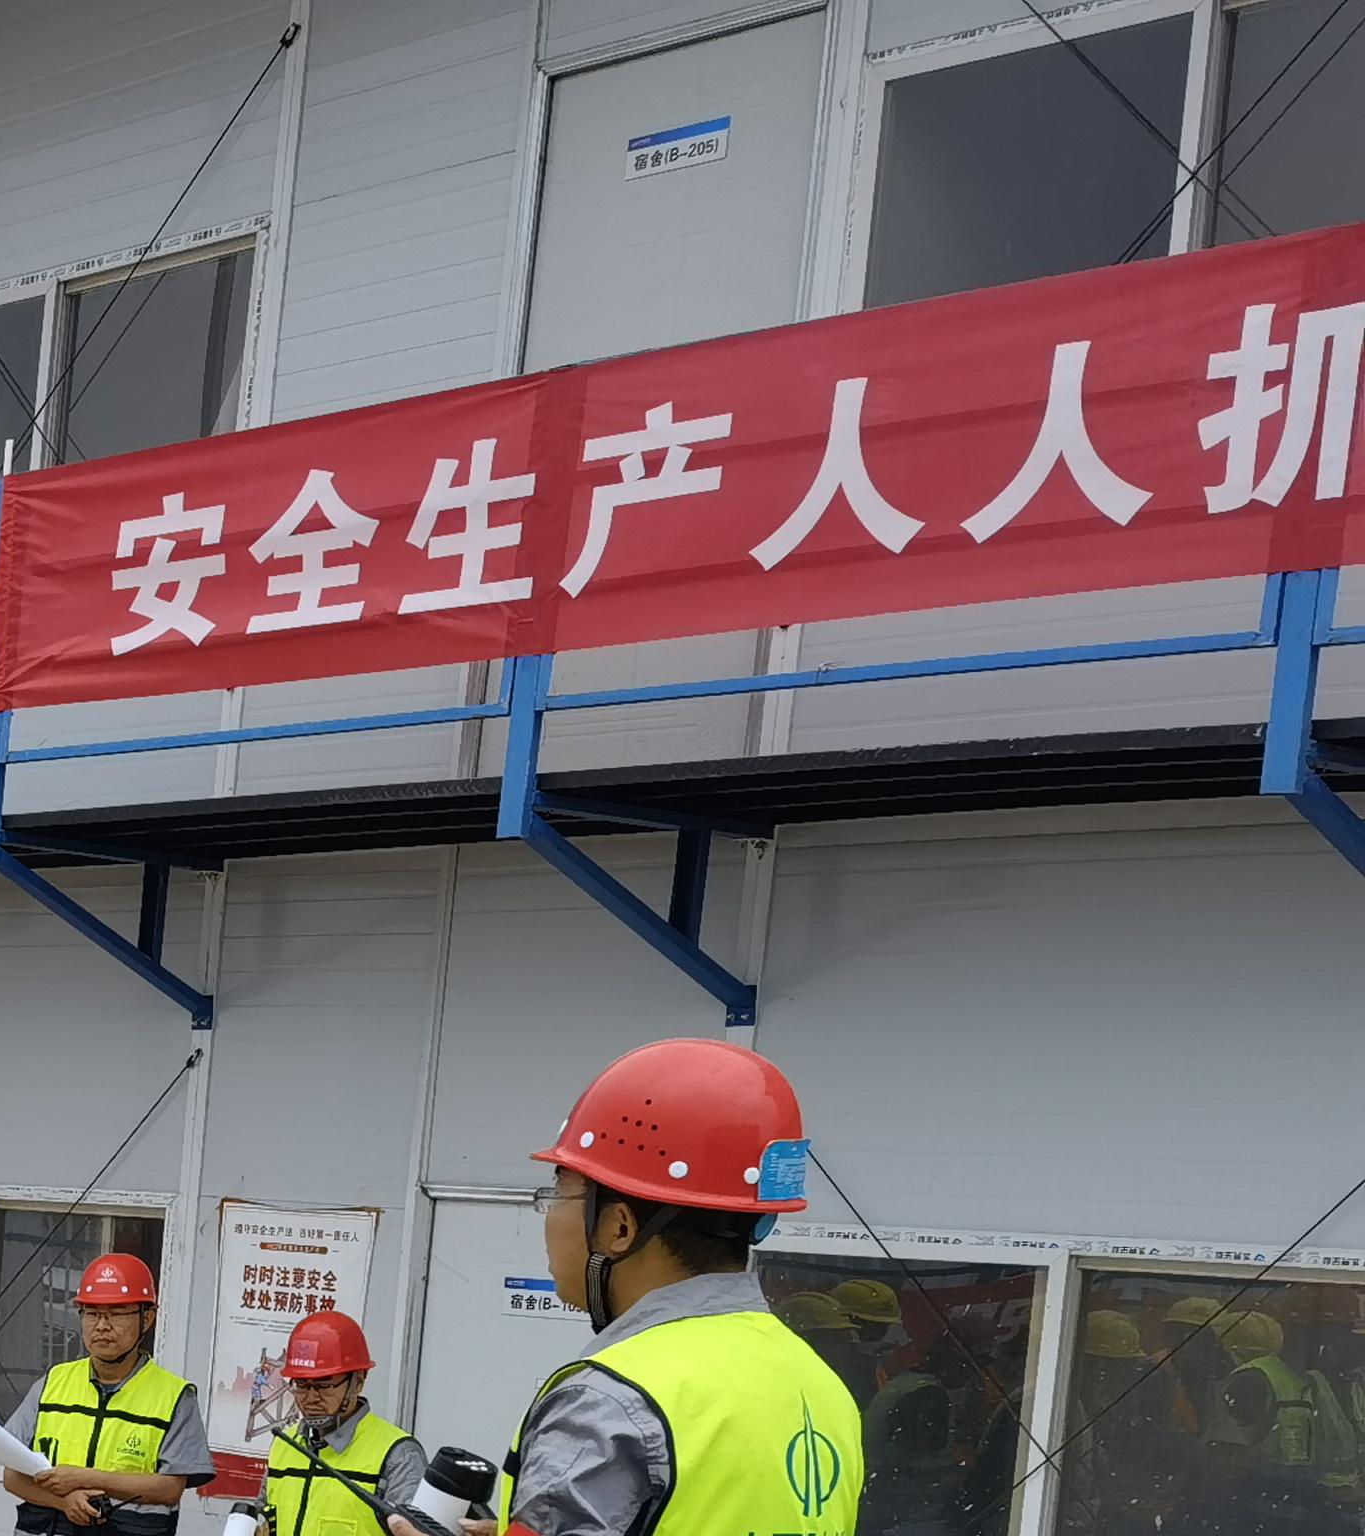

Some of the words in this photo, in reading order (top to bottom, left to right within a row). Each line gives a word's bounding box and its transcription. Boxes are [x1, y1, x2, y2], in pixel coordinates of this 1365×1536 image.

[107, 303, 1365, 659] 安全生产人人抓
[242, 1263, 338, 1293] 时时注意安全
[240, 1287, 337, 1316] 处处预防事故
